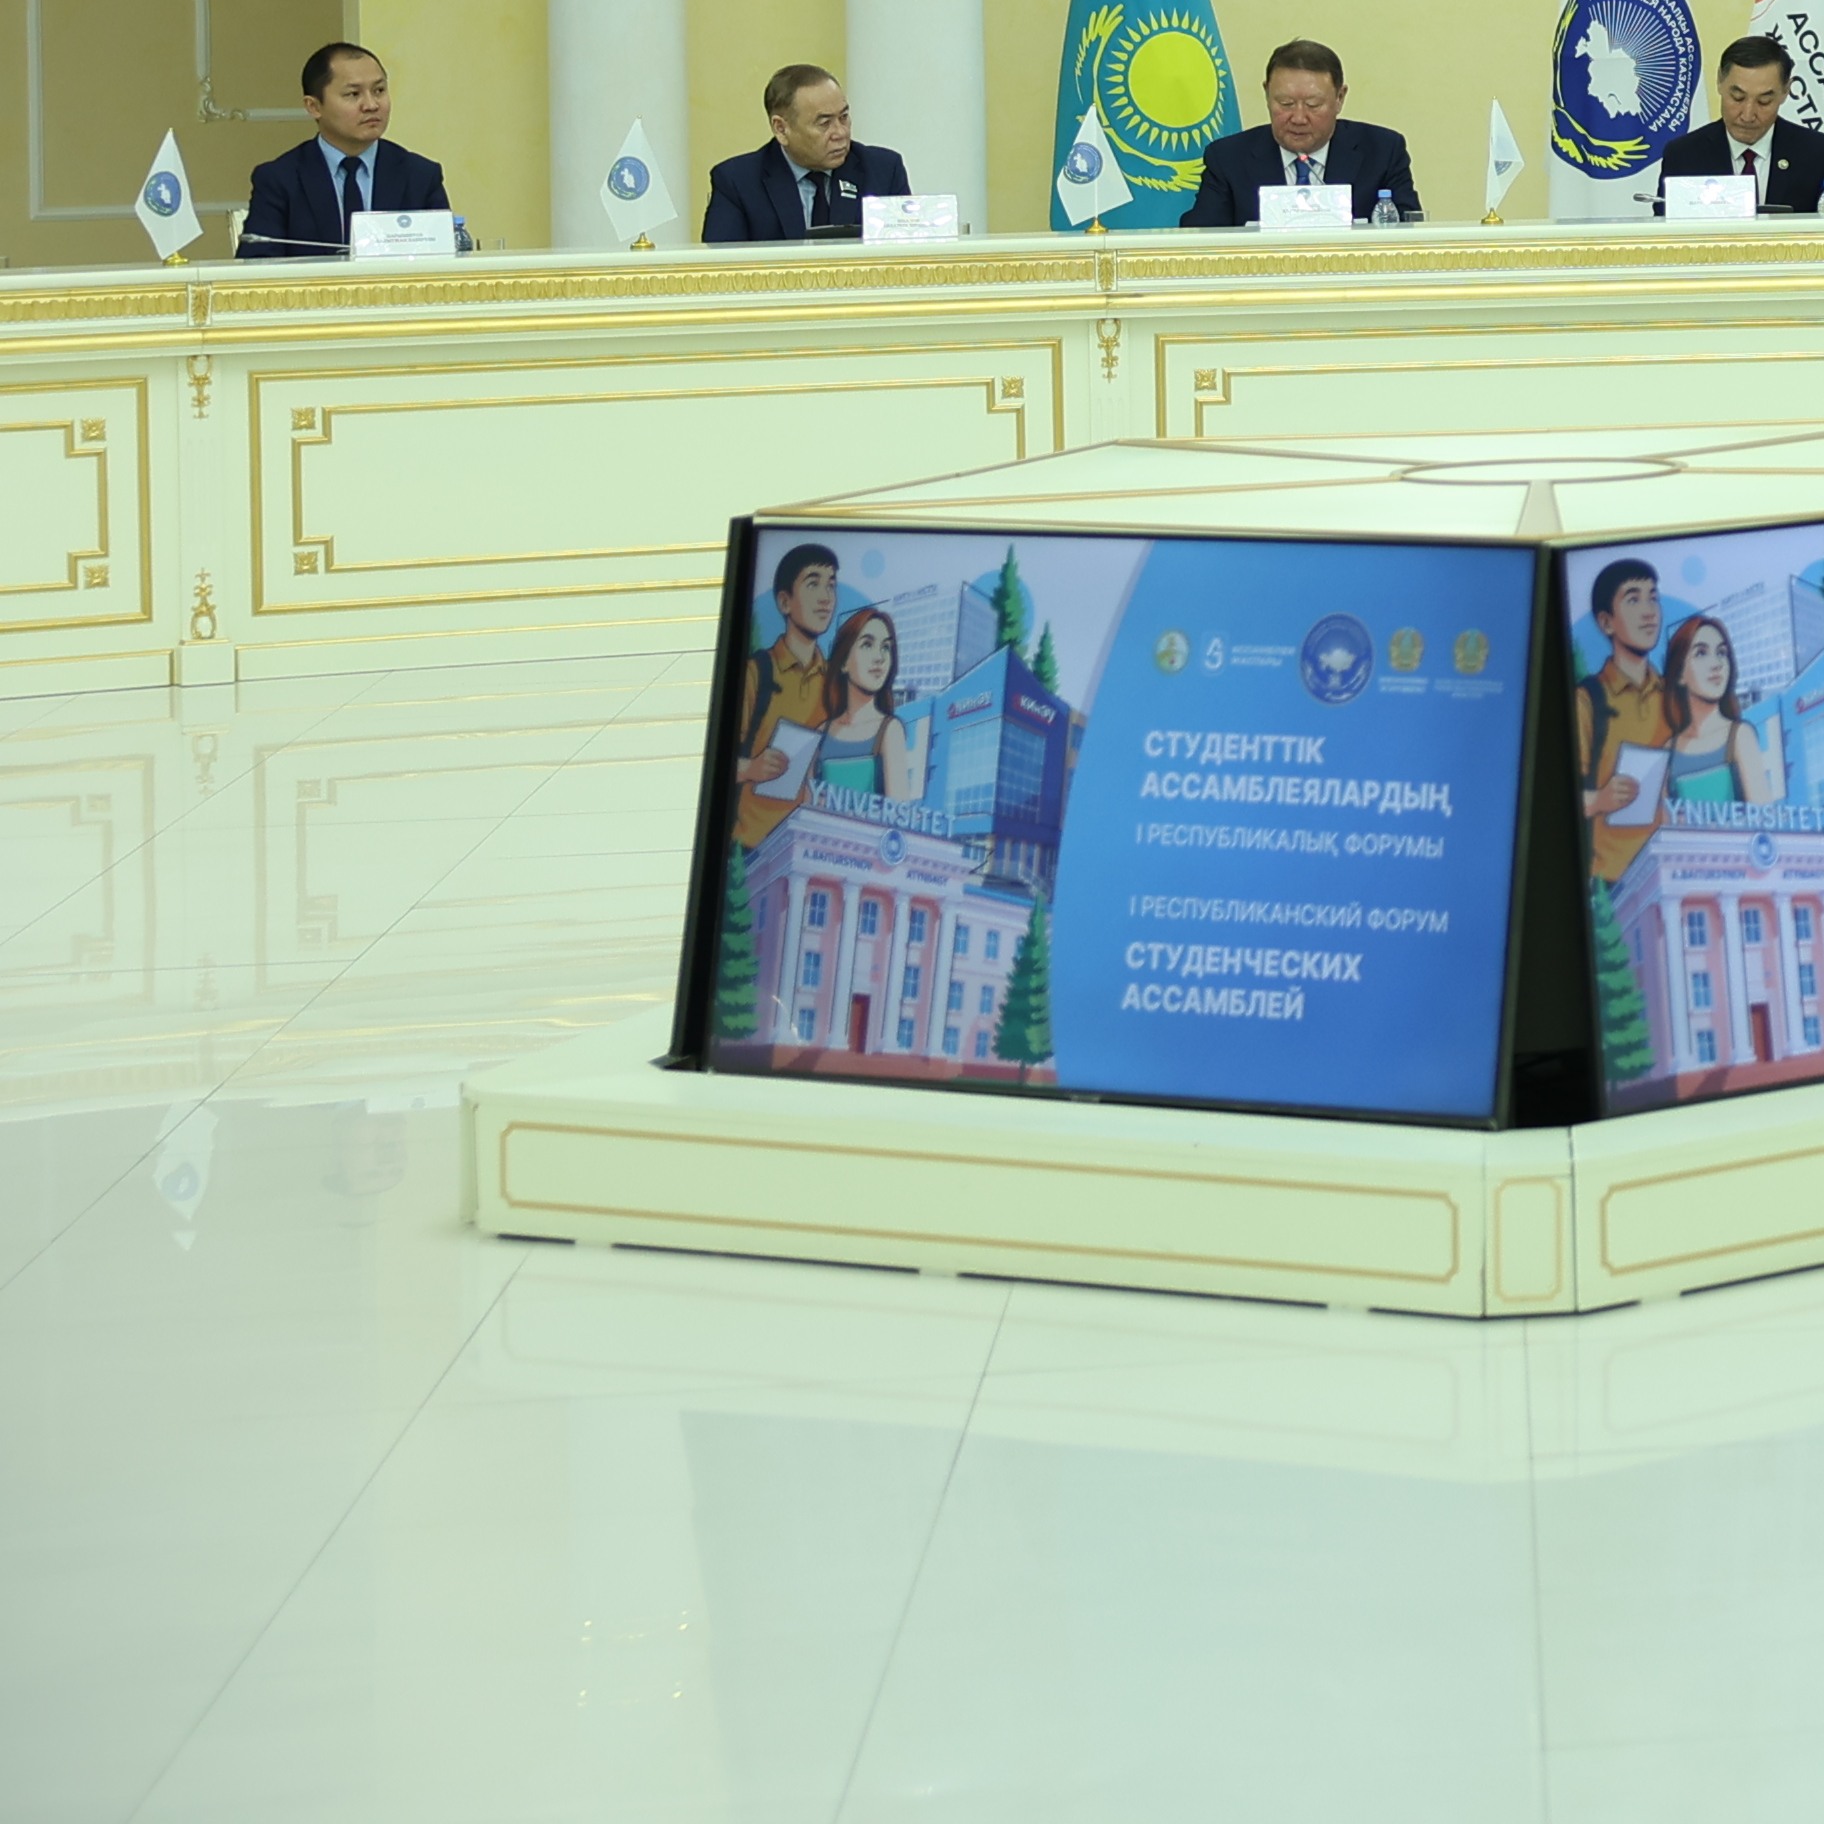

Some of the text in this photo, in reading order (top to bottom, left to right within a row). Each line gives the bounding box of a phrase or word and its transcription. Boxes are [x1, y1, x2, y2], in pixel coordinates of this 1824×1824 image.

[1658, 4, 1686, 55] НАРОДА
[1648, 57, 1688, 133] КАЗАХСТАНА
[1144, 730, 1326, 765] СТУДЕНТТІК
[808, 778, 956, 838] YNIVERSITET
[1140, 771, 1452, 818] АССАМБЛЕЯЛАРДЫҢ
[1663, 798, 1824, 832] YNIVERSITET
[1147, 823, 1339, 857] РЕСПУБЛИКАЛЫҚ
[1343, 832, 1445, 859] ФОРУМЫ
[1140, 895, 1362, 929] РЕСПУБЛИКАНСКИЙ
[1366, 907, 1450, 934] ФОРУМ
[1125, 941, 1363, 983] СТУДЕНЧЕСКИХ
[1121, 982, 1306, 1021] АССАМБЛЕЙ
